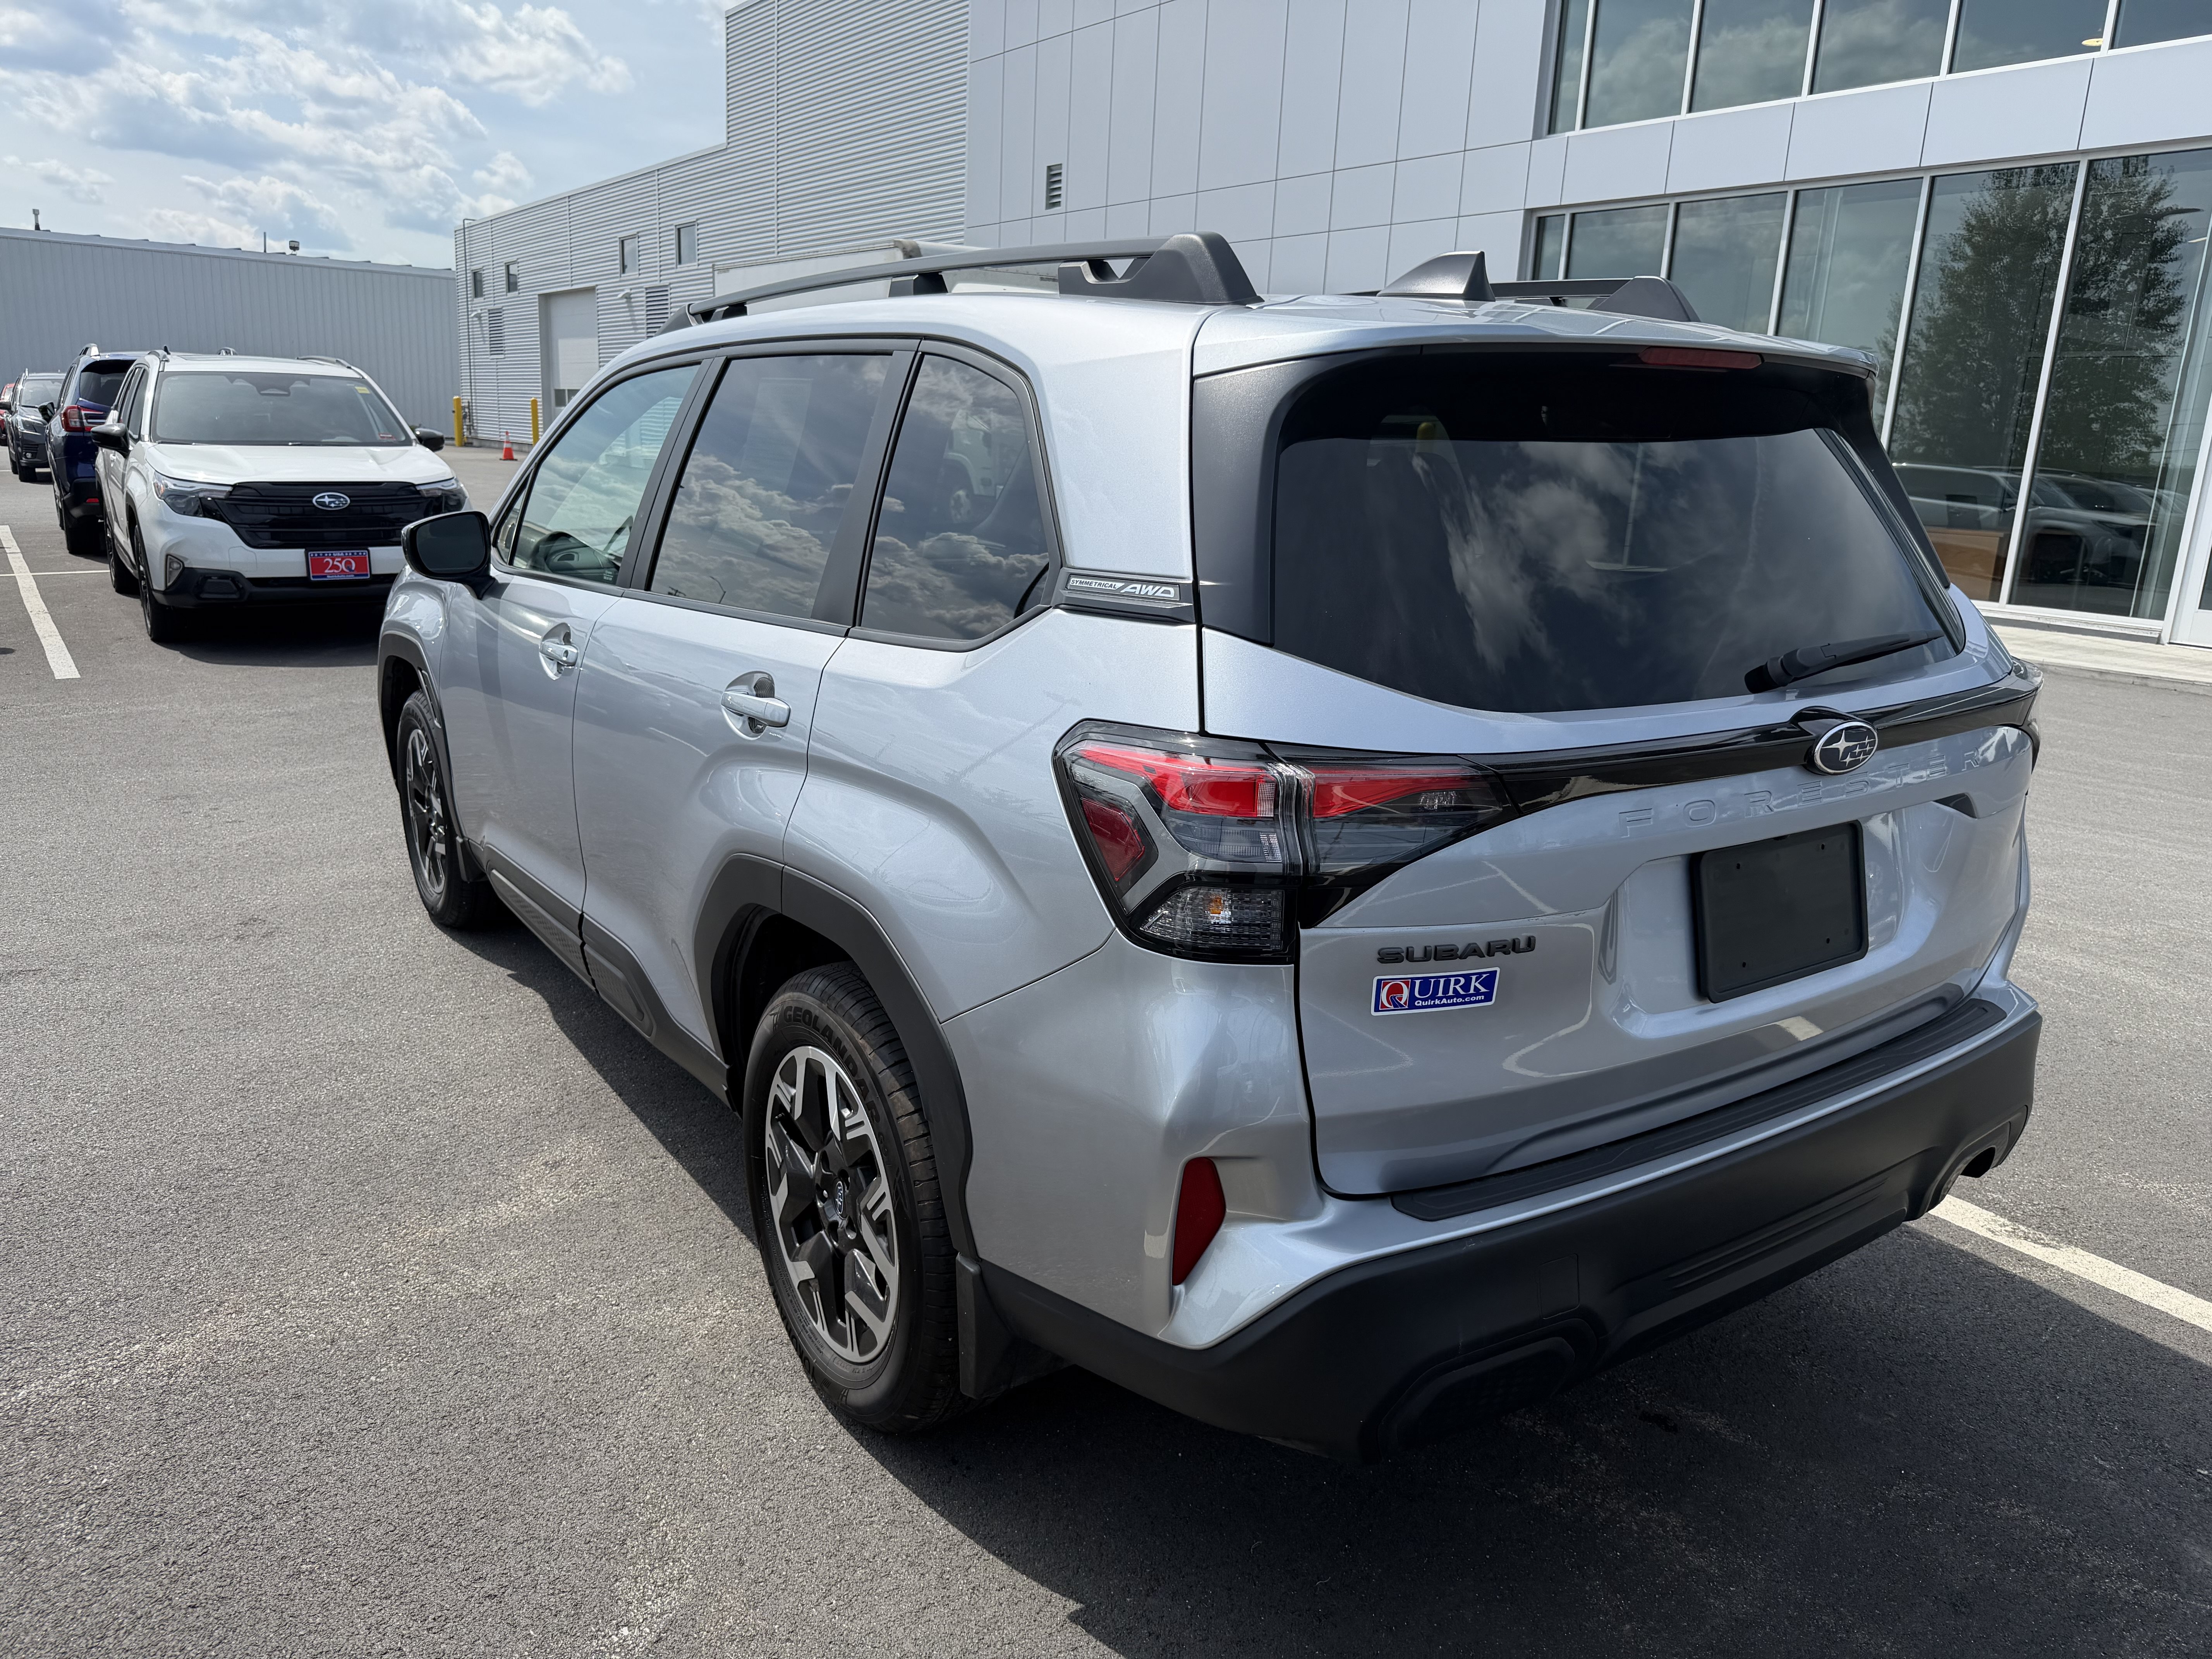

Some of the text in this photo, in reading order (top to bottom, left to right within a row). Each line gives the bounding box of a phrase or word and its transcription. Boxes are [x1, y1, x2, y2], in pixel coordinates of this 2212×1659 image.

[1071, 579, 1175, 598] SYMMETRICAL AWD
[1619, 747, 1980, 838] FORESTER
[1377, 935, 1536, 963] SUBARU
[1380, 974, 1490, 1008] QUIRK
[1415, 994, 1484, 1006] QuirkAuto.com
[783, 1006, 881, 1124] GEOLANDAR
